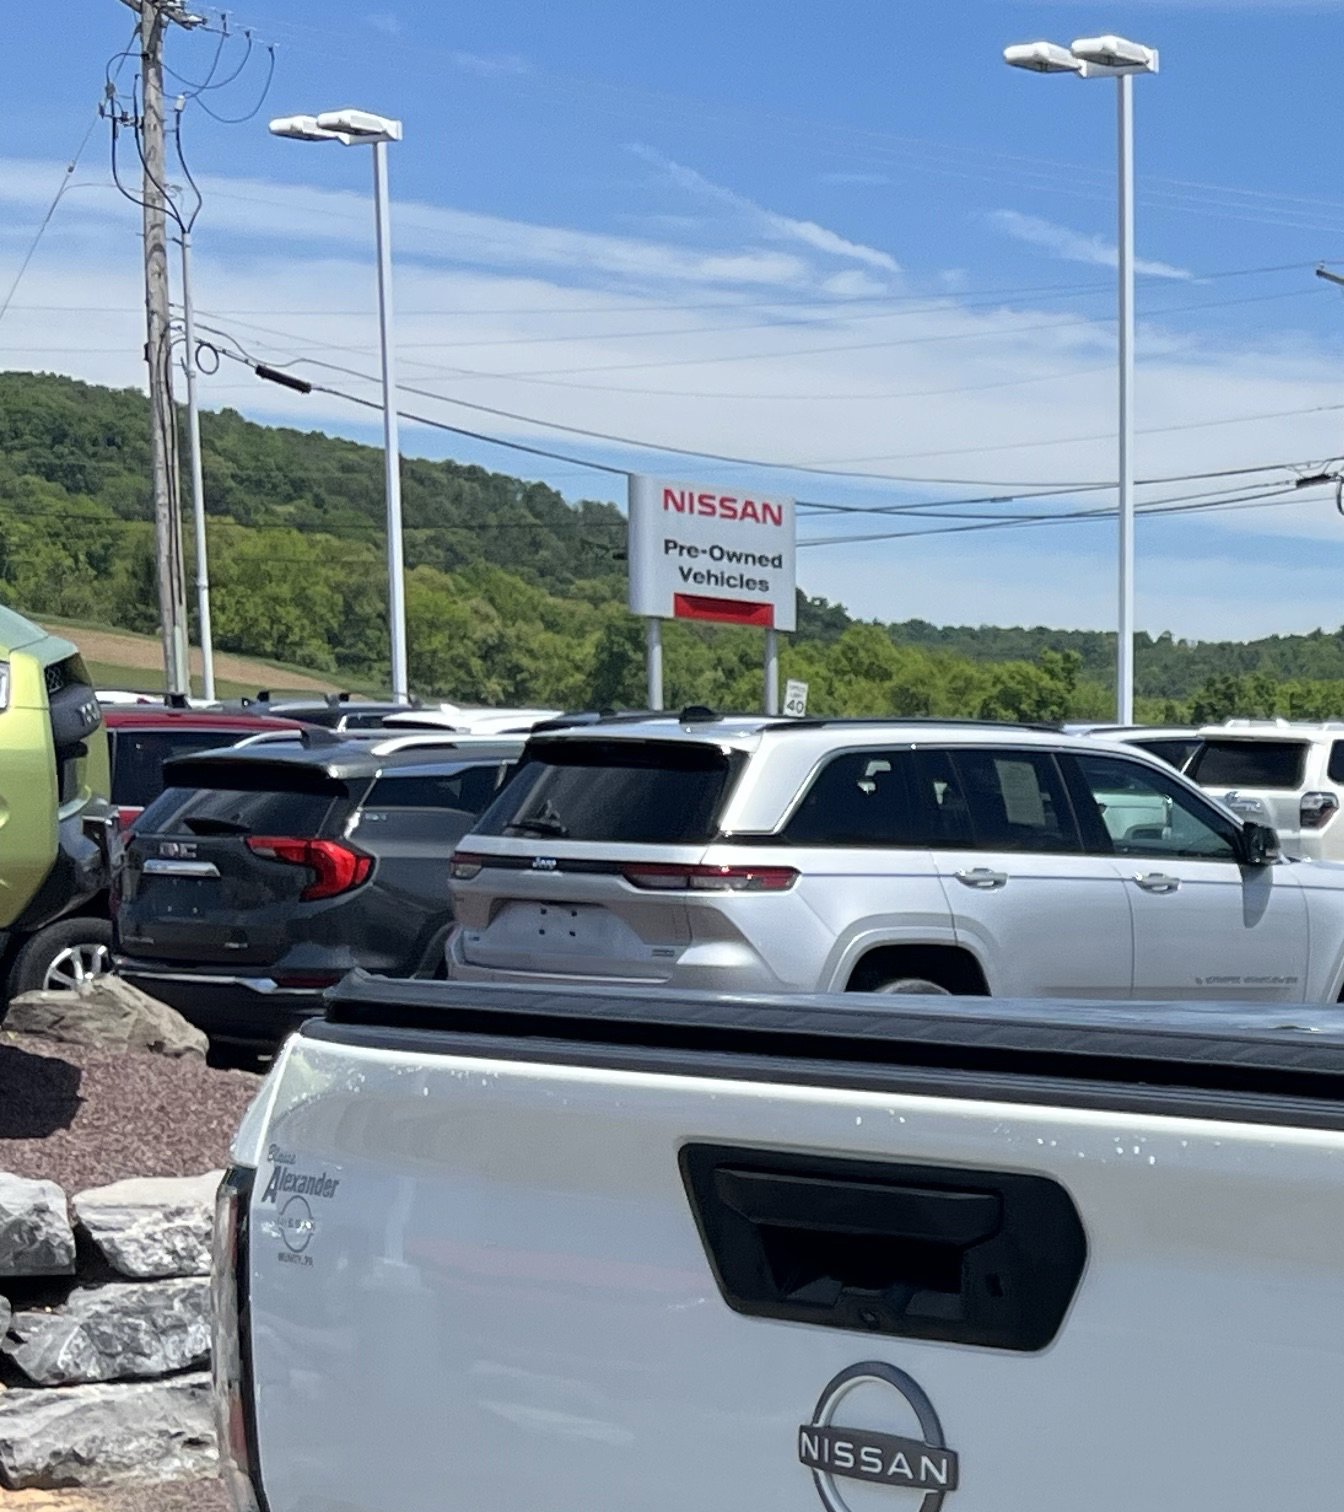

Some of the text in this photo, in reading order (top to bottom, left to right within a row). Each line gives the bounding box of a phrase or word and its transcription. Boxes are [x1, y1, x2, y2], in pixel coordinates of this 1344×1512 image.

[663, 488, 783, 527] NISSAN
[664, 538, 783, 569] Pre-Owned
[678, 565, 770, 592] Vehicles
[787, 700, 804, 714] 40
[261, 1165, 341, 1204] Alexander
[800, 1431, 948, 1485] NISSAN
